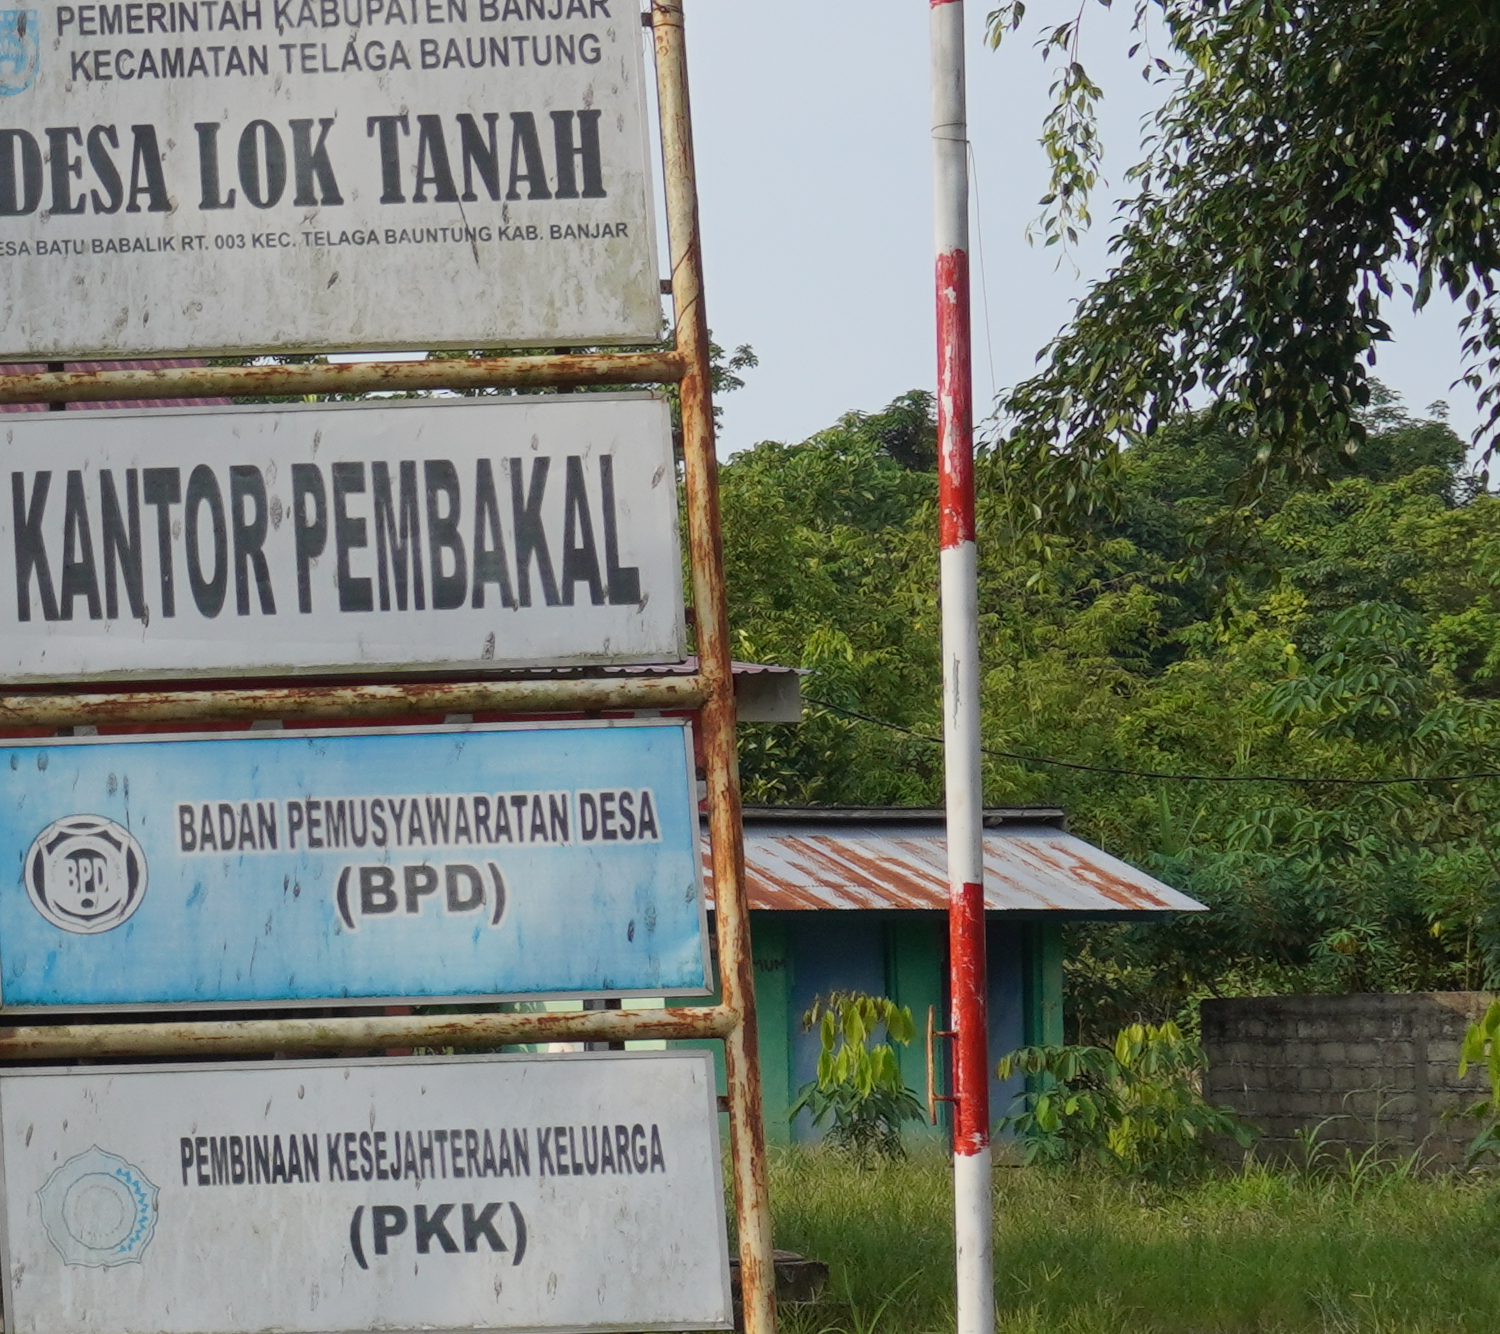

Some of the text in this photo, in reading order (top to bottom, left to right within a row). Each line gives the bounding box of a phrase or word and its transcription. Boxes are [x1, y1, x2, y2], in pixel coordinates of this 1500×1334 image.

[57, 0, 262, 37] PEMERINTAH
[70, 33, 601, 82] KECAMATAN TELAGA BAUNTUNG
[194, 118, 344, 210] LOK
[367, 108, 607, 204] TANAH
[36, 239, 85, 255] BATU
[91, 236, 175, 254] BABALIK
[181, 235, 208, 251] RT.
[214, 234, 246, 250] 003
[252, 232, 296, 248] KEC.
[302, 229, 380, 247] TELAGA
[384, 226, 492, 244] BAUNTUNG
[498, 225, 543, 241] KAB.
[550, 222, 629, 240] BANJAR
[11, 454, 645, 622] KANTOR PEMBAKAL
[179, 791, 658, 852] BADAN PEMUSYAWARATAN DESA
[64, 857, 109, 894] BPD
[337, 863, 505, 928] (BPD)
[180, 1124, 665, 1186] PEMBINAAN KESEJAHTERAAN KELUARGA
[350, 1202, 527, 1270] (PKK)
